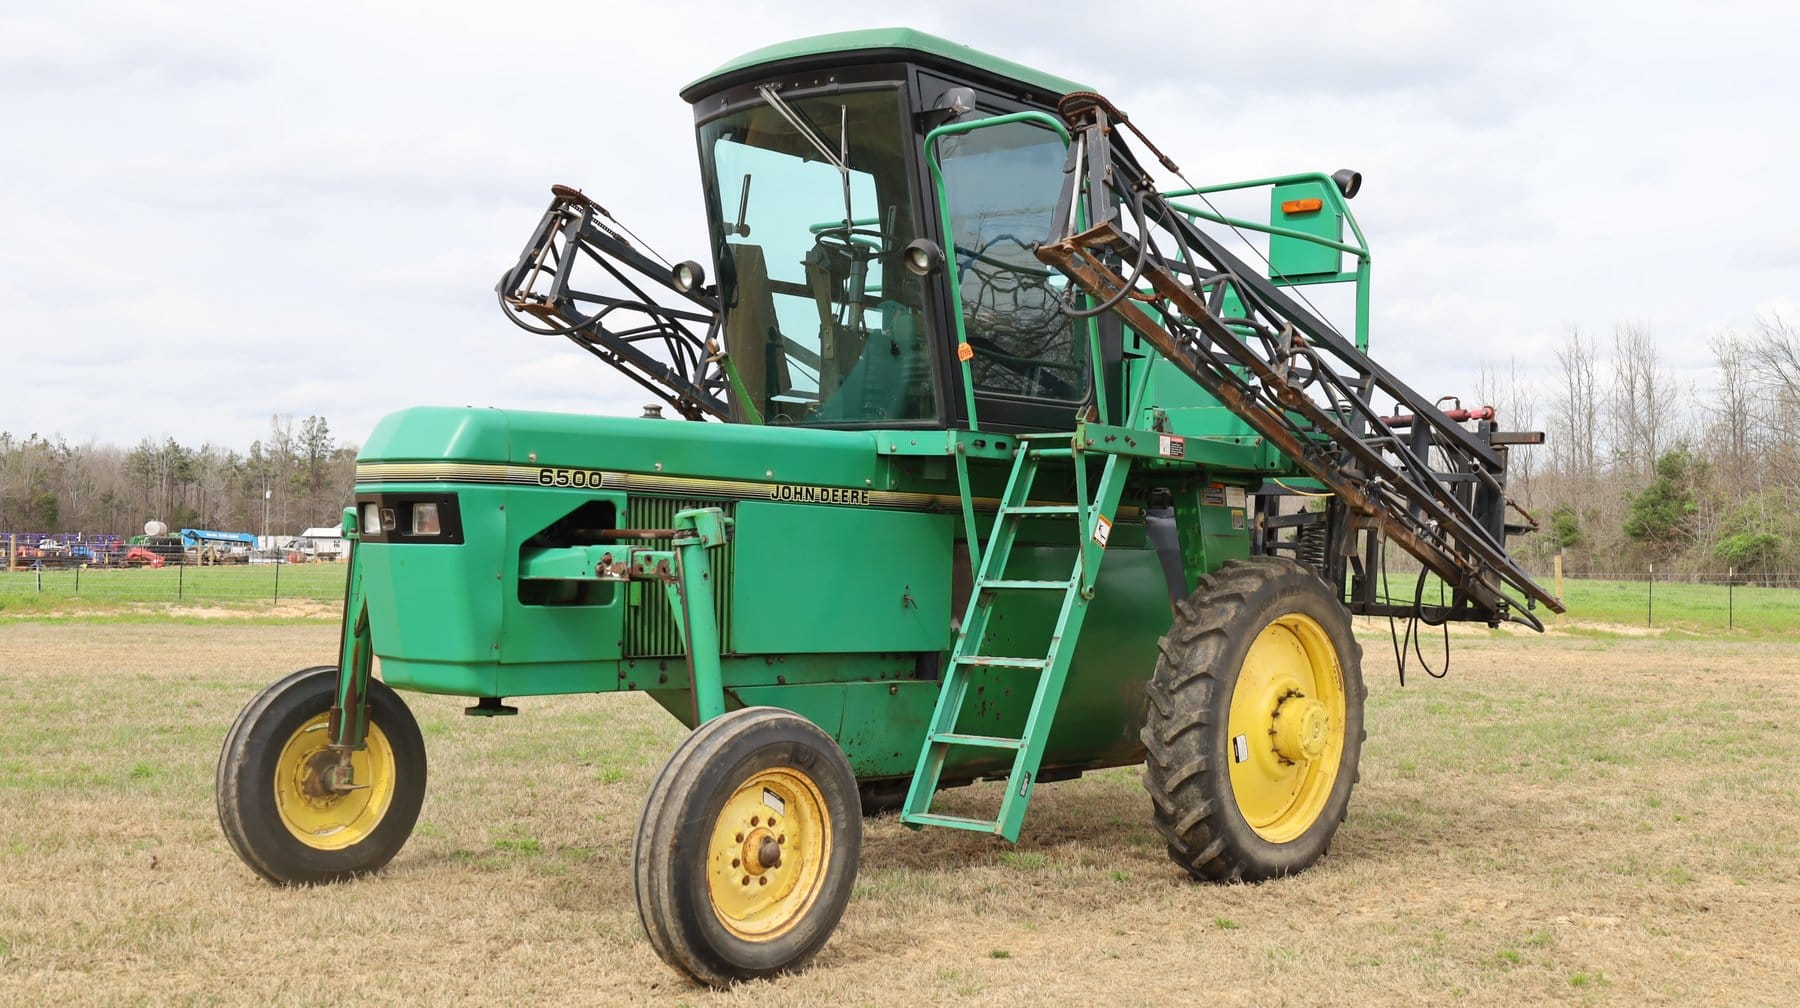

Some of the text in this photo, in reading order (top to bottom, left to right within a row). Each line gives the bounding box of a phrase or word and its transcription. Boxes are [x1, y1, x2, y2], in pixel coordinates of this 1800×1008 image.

[539, 468, 602, 487] 6500
[770, 485, 869, 505] JOHN DEERE
